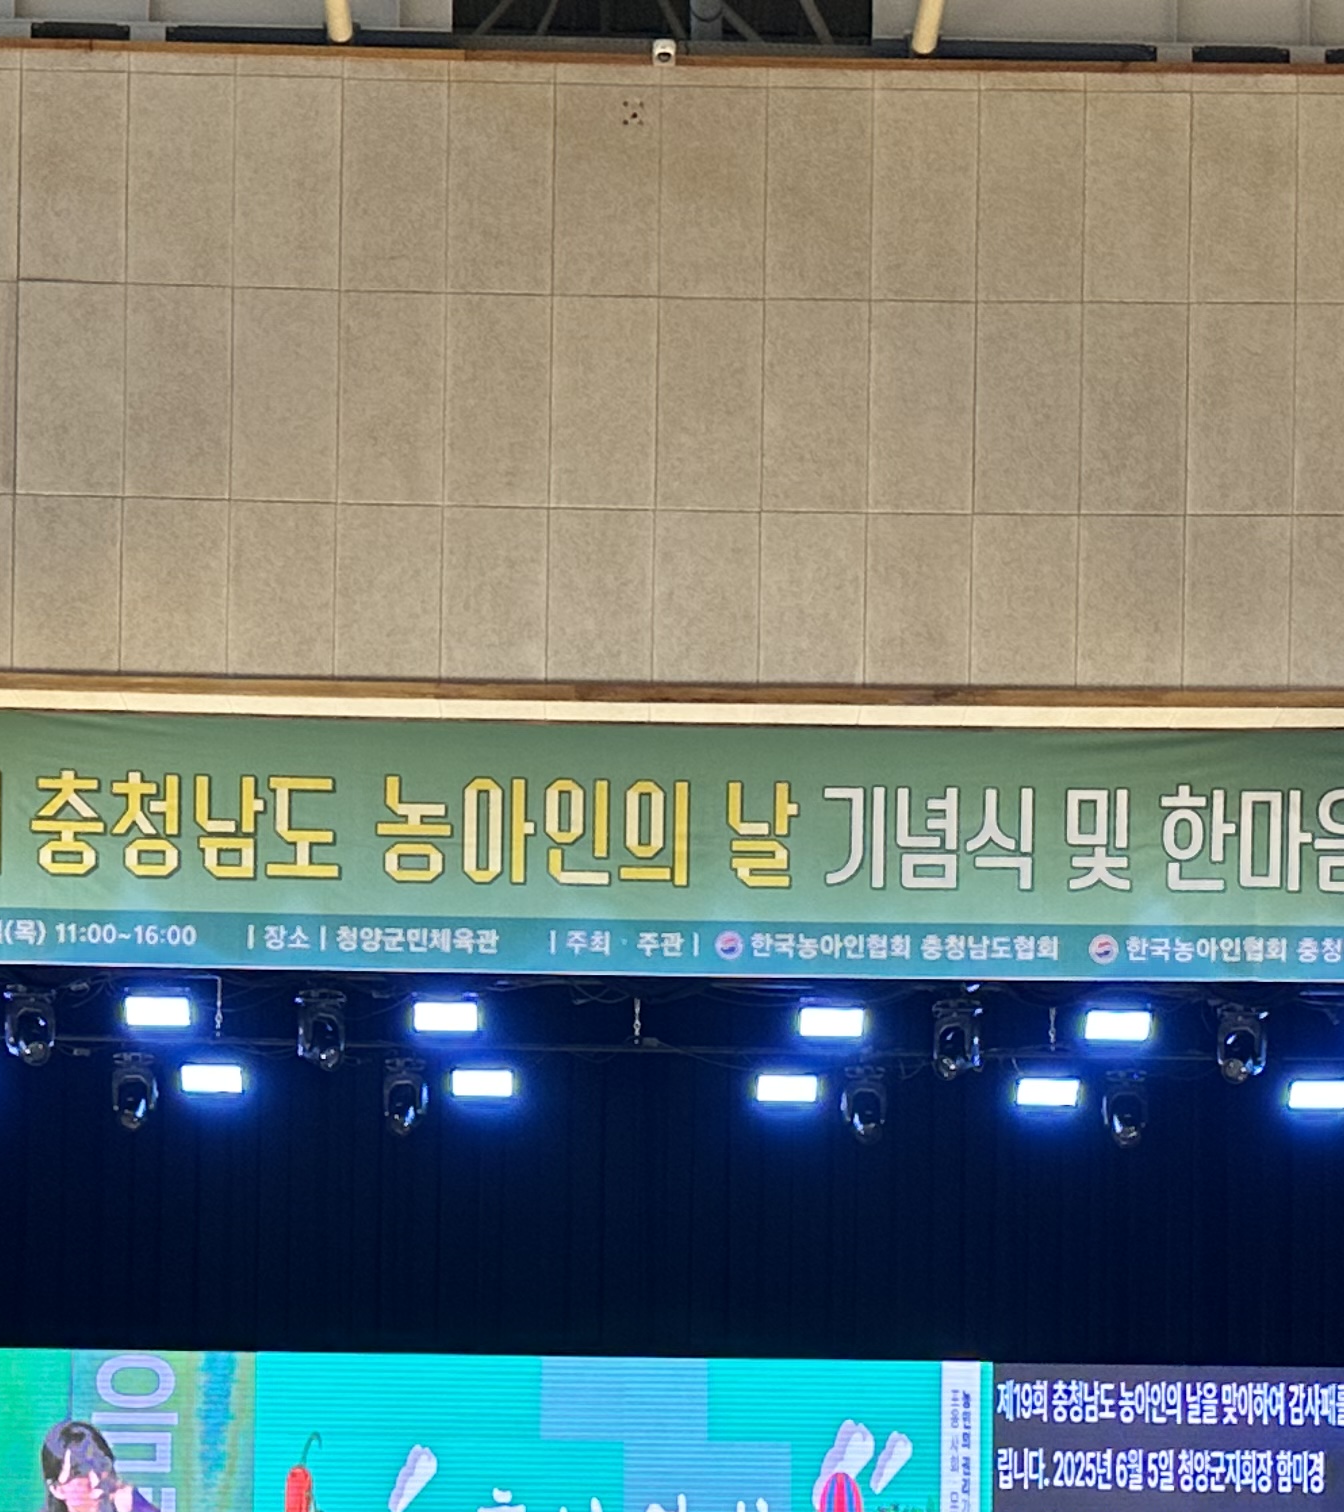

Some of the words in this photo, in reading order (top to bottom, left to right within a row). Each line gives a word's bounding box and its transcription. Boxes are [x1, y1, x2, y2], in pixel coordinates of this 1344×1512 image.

[29, 768, 343, 880] 충청남도
[374, 773, 690, 889] 농아인의
[726, 780, 800, 889] 날
[822, 785, 1034, 891] 기념식
[1065, 787, 1133, 892] 및
[55, 922, 197, 948] 11:00~16:00
[264, 925, 310, 951] 장소
[336, 927, 499, 955] 청양군민체육관
[750, 932, 911, 960] 한국농아인협회
[920, 935, 1059, 962] 충청남도협회
[1126, 936, 1287, 964] 한국농아인협회
[996, 1379, 1048, 1423] 제19회
[1052, 1380, 1116, 1424] 충청남도
[1118, 1380, 1182, 1425] 농아인의
[1185, 1381, 1218, 1425] 날을
[1222, 1382, 1285, 1426] 맞이하여
[996, 1448, 1050, 1491] 립니다.
[1053, 1449, 1112, 1491] 2025년
[1115, 1449, 1144, 1491] 6월
[1146, 1449, 1175, 1492] 5일
[1177, 1449, 1273, 1493] 청양군지회장
[1276, 1450, 1325, 1494] 함미경
